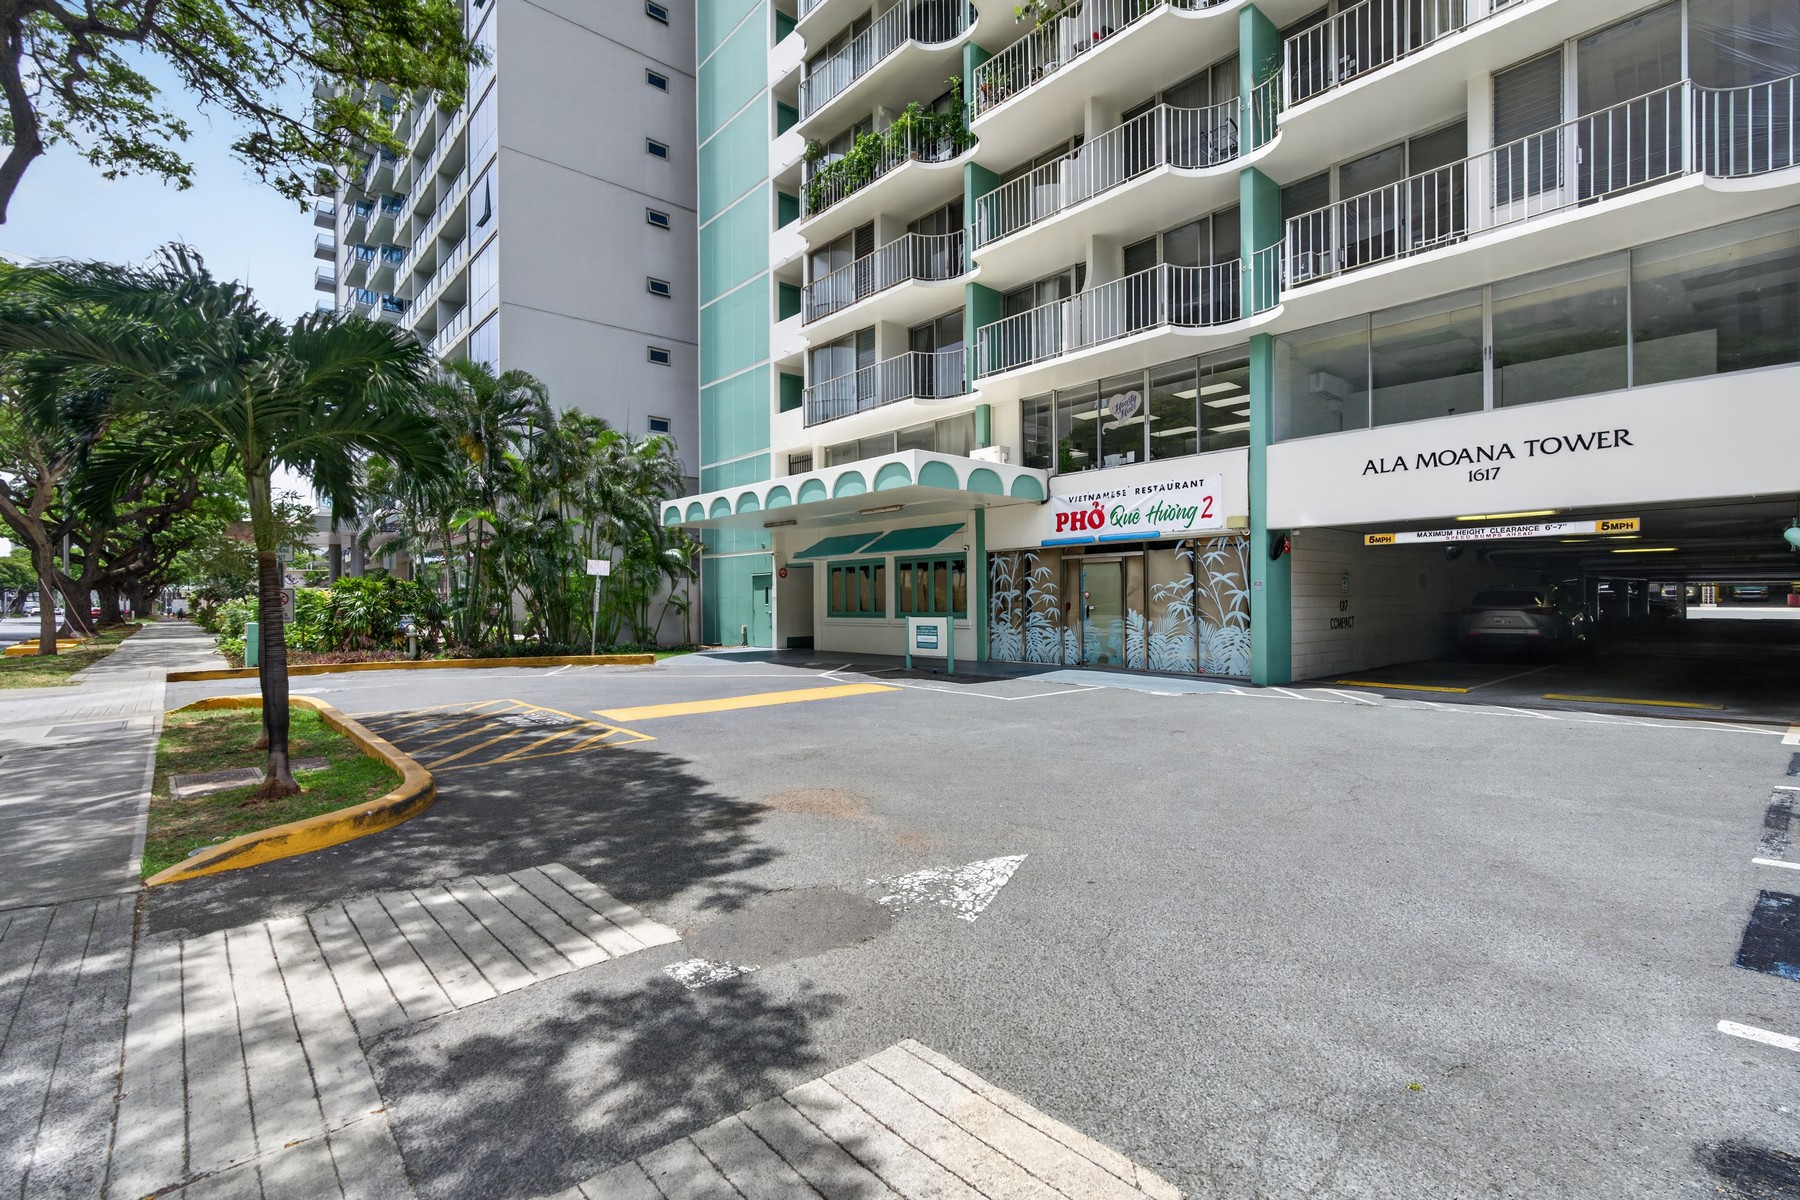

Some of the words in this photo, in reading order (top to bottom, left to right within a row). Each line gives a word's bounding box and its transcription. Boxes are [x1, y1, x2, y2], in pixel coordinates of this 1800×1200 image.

[1362, 456, 1409, 476] ALA
[1415, 443, 1516, 470] MOANA
[1524, 428, 1634, 457] TOWER
[1468, 467, 1501, 482] 1617
[1068, 489, 1127, 503] VIETNAMESE
[1135, 479, 1205, 495] RESTAURANT
[1055, 501, 1106, 532] PHỞ
[1110, 504, 1141, 528] Quê
[1201, 495, 1214, 519] 2
[1416, 530, 1453, 538] MAXIMUM
[1456, 528, 1486, 536] HEIGHT
[1489, 525, 1540, 534] CLEARANCE
[1600, 521, 1634, 531] 5MPH
[1368, 535, 1392, 543] 5MPH
